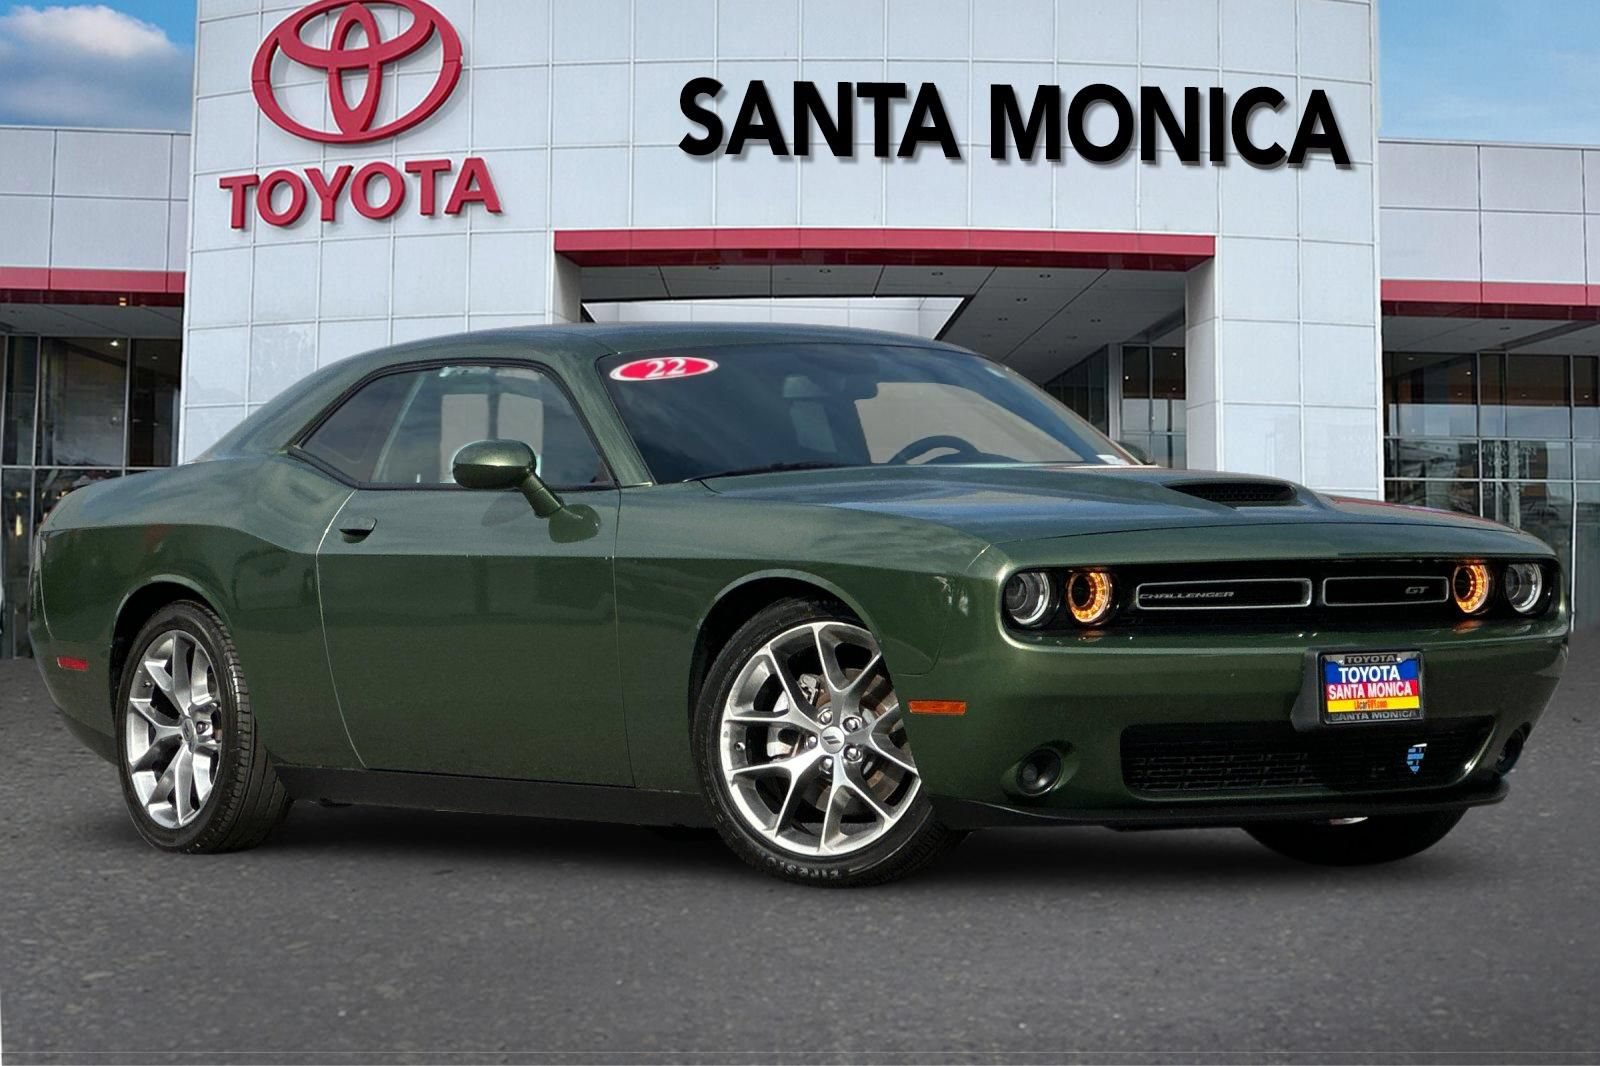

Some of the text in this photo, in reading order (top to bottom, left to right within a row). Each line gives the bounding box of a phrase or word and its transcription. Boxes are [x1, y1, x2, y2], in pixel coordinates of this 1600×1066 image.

[678, 77, 1352, 167] SANTA MONICA
[218, 157, 503, 230] TOYOTA
[644, 358, 687, 378] 22
[1140, 592, 1234, 600] CHALLENGER
[1405, 586, 1430, 594] GT
[1346, 654, 1396, 663] TOYOTA
[1338, 665, 1401, 683] TOYOTA
[1328, 681, 1412, 700] SANTA MONICA
[1331, 710, 1417, 721] SANTA MONICA
